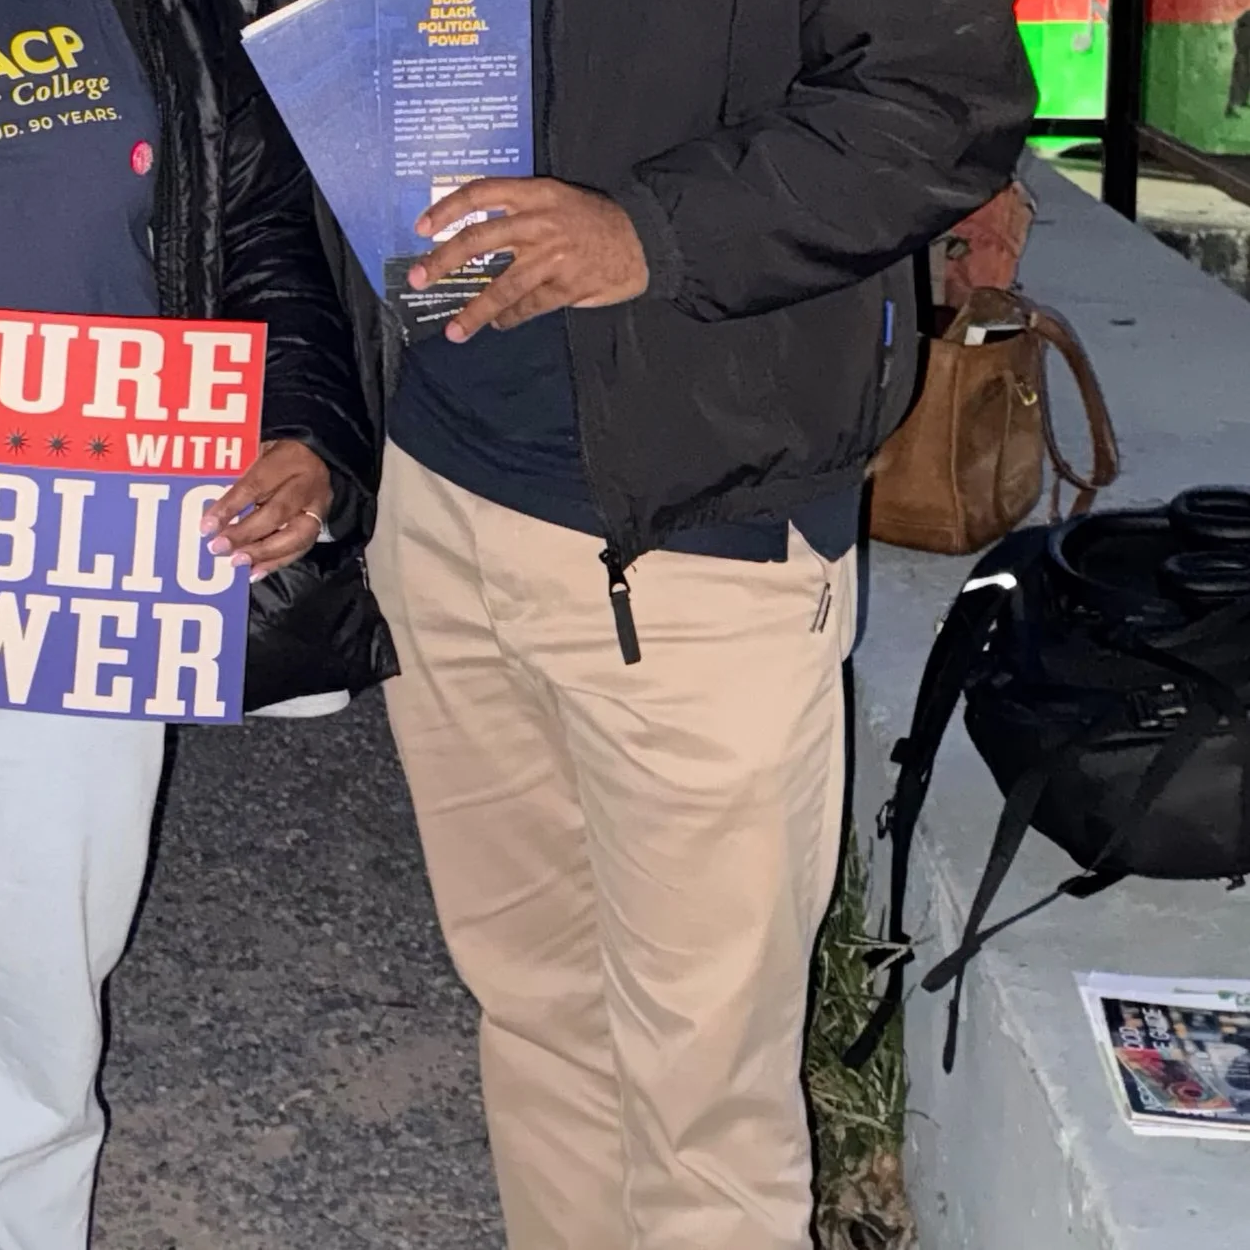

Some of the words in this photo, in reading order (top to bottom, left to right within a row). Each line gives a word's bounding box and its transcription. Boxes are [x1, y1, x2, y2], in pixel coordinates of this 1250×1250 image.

[430, 6, 477, 19] BLACK
[418, 20, 490, 34] POLITICAL
[428, 33, 479, 47] POWER
[12, 74, 111, 108] College
[28, 117, 54, 134] 90
[57, 106, 123, 128] YEARS.
[126, 433, 243, 470] WITH
